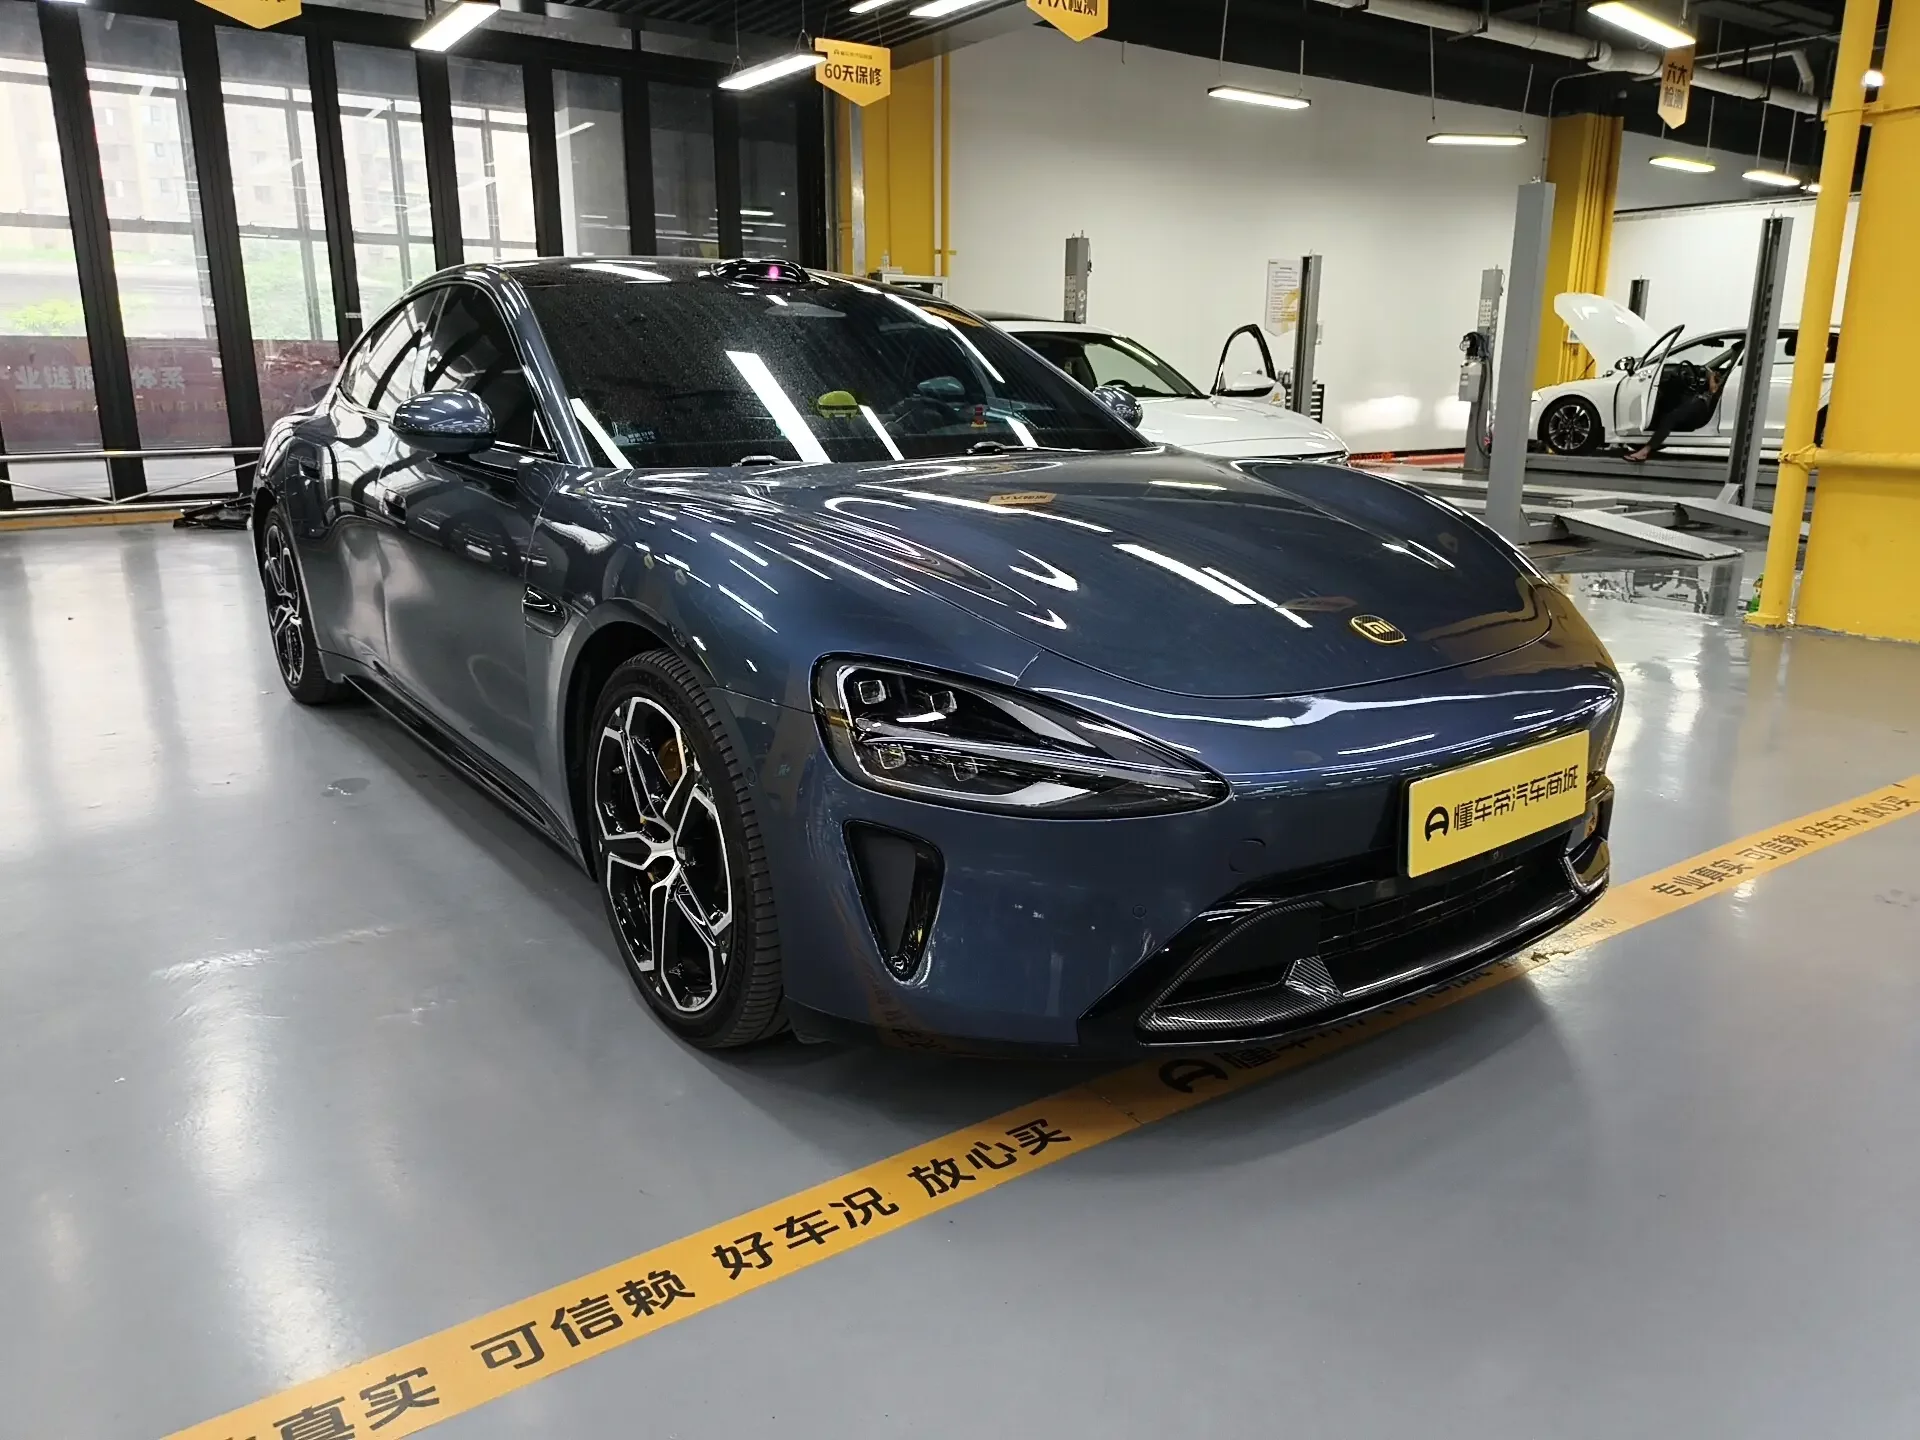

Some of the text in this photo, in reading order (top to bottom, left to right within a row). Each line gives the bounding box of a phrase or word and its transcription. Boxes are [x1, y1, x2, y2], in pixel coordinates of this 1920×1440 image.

[825, 63, 882, 86] 60天保修
[1666, 62, 1688, 86] 六大
[1453, 765, 1579, 830] 懂车帝汽车商城
[1650, 795, 1919, 897] 专业真实 可信赖 好车况 放心买
[223, 1118, 1072, 1440] 真实 可信赖 好车况 放心买
